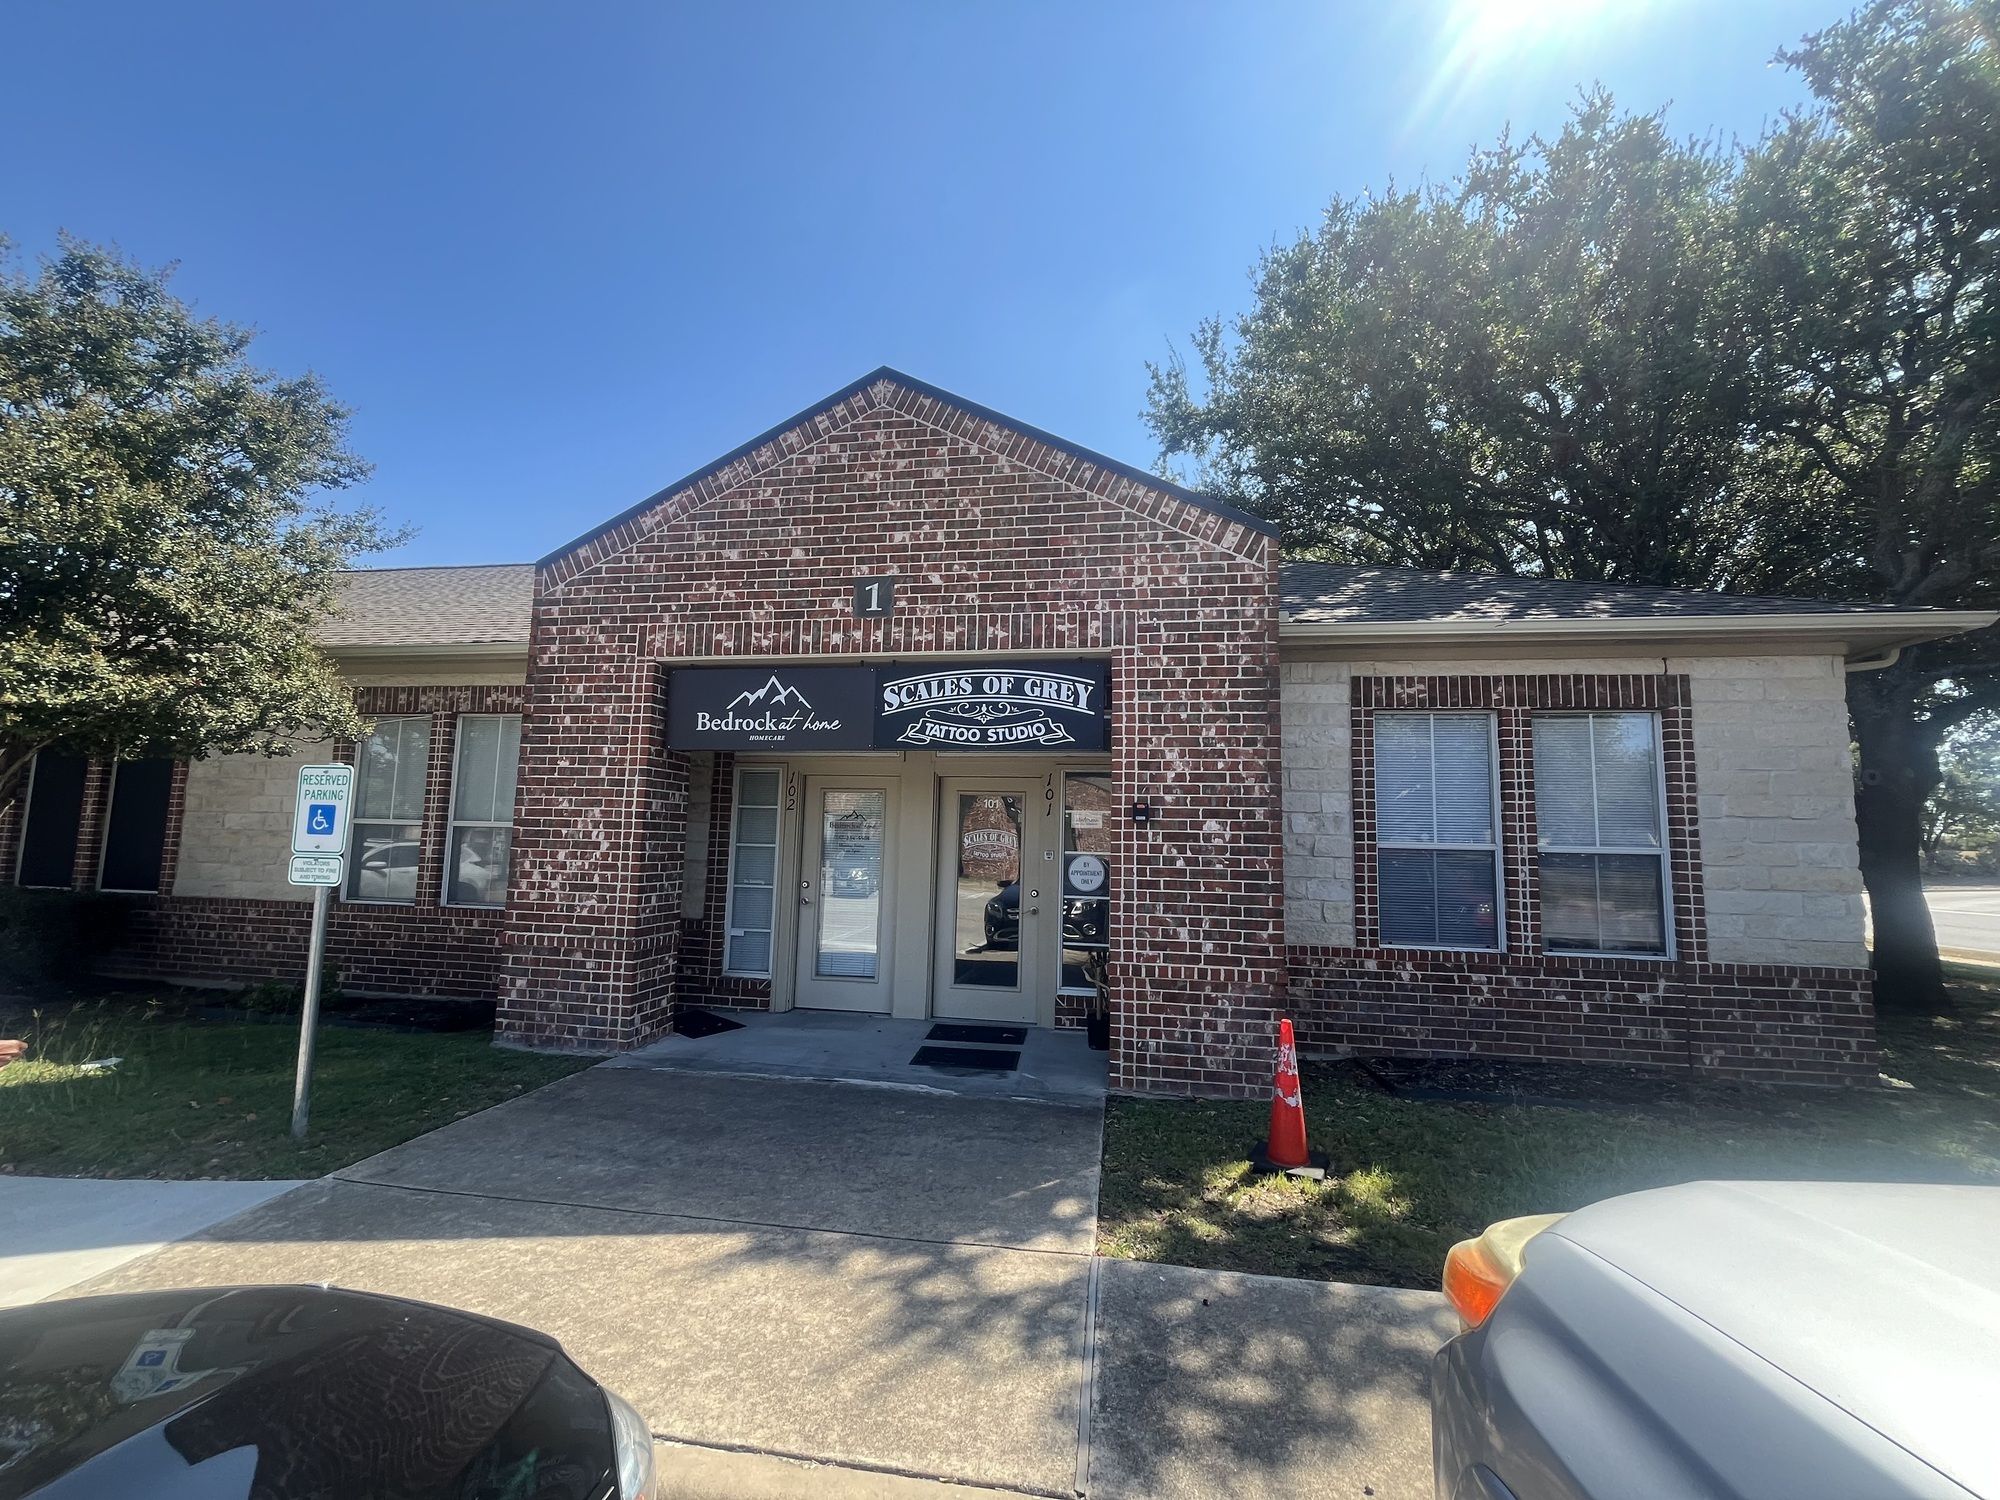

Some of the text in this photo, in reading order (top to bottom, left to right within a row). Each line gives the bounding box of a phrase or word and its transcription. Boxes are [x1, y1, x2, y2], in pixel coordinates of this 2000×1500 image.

[865, 582, 882, 611] 1
[883, 676, 1093, 711] SCALES OF GREY
[695, 709, 842, 731] Bedrock at home
[925, 722, 1046, 742] TATTOO STUDIO
[302, 774, 348, 787] RESERVED
[787, 771, 796, 811] 102
[303, 789, 344, 801] PARKING
[983, 798, 999, 809] 101
[1045, 773, 1054, 817] 101
